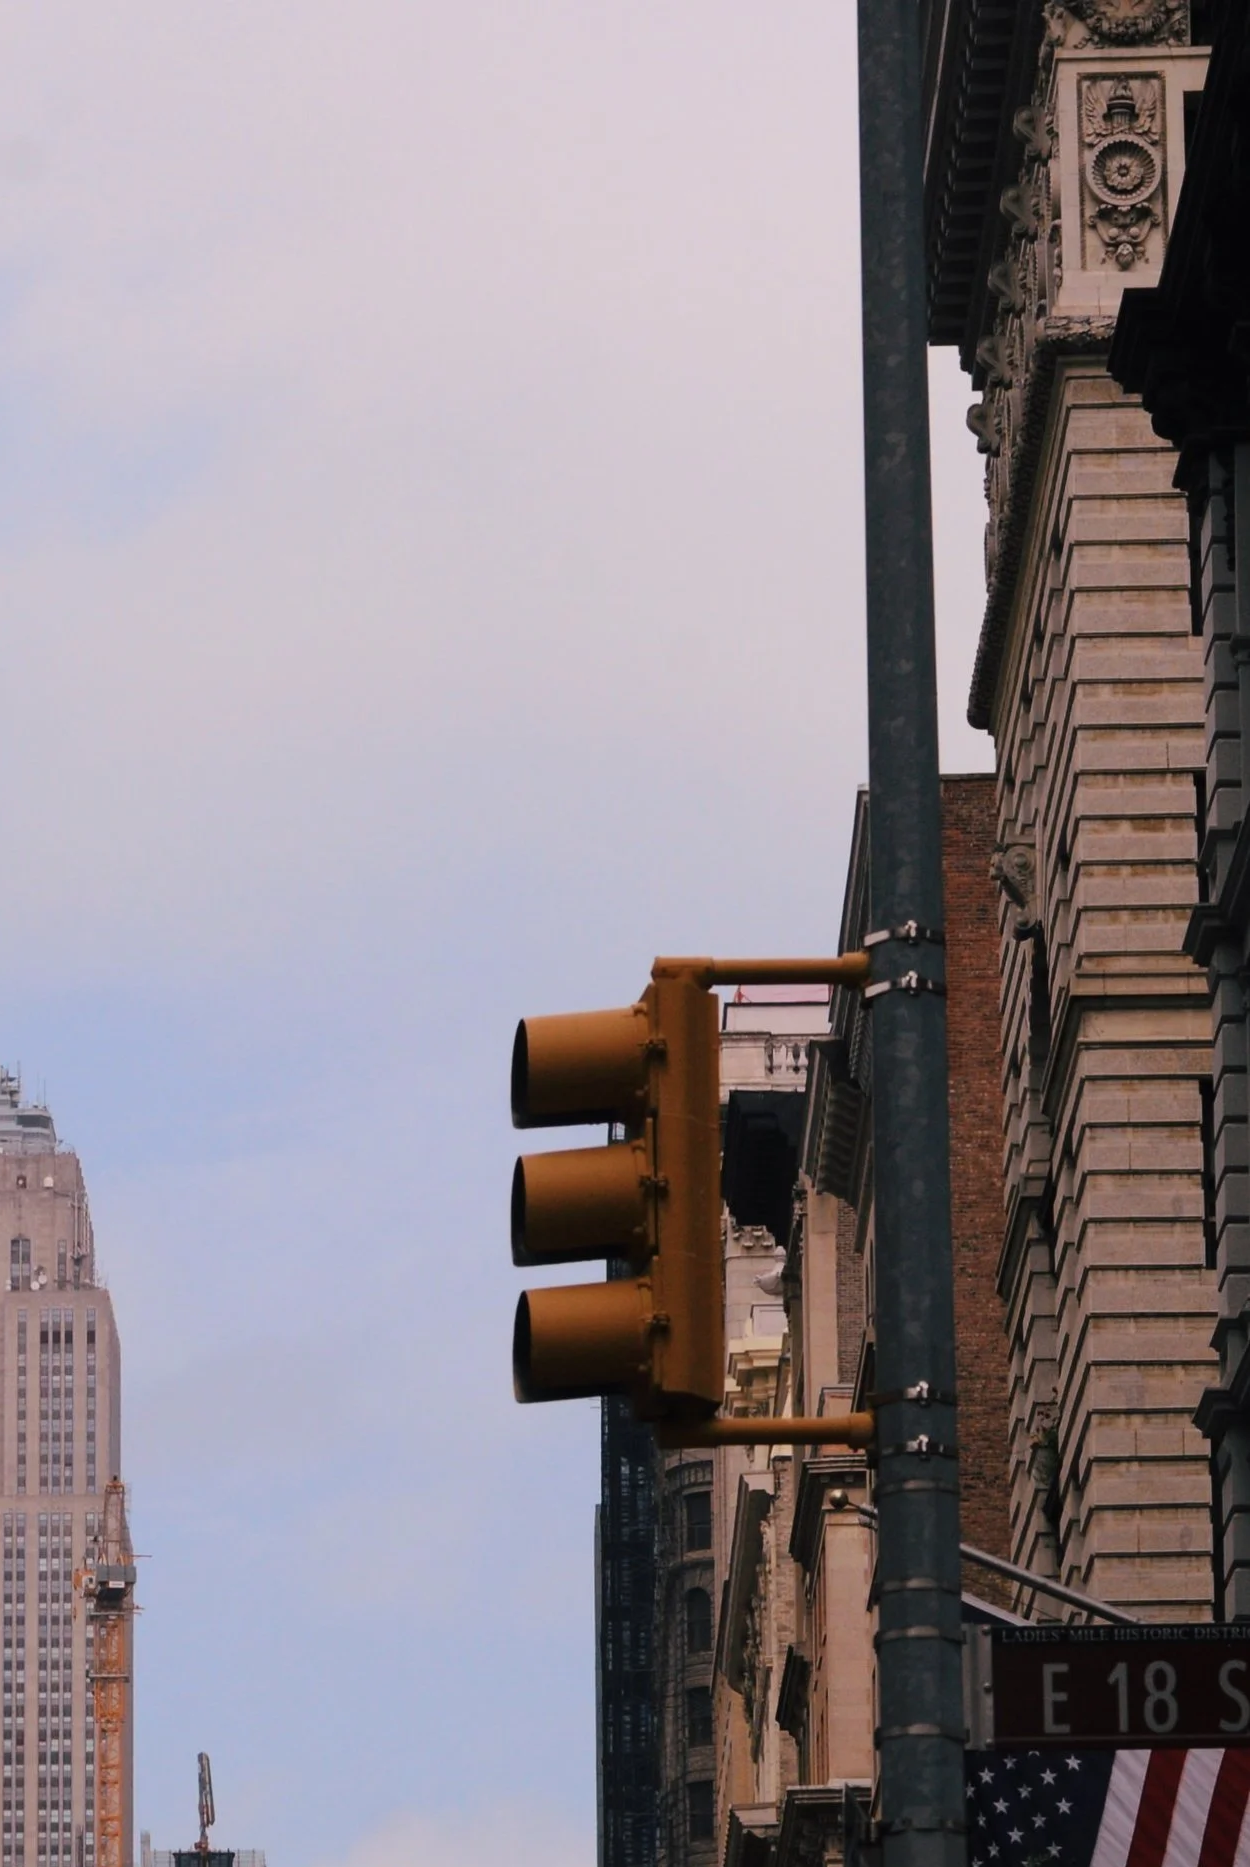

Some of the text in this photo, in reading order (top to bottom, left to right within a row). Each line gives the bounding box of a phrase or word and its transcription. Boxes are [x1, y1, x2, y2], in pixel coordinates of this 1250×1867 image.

[1070, 1628, 1109, 1642] MILE
[1114, 1627, 1190, 1641] HISTORIC
[1042, 1662, 1071, 1734] E
[1106, 1660, 1179, 1733] 18
